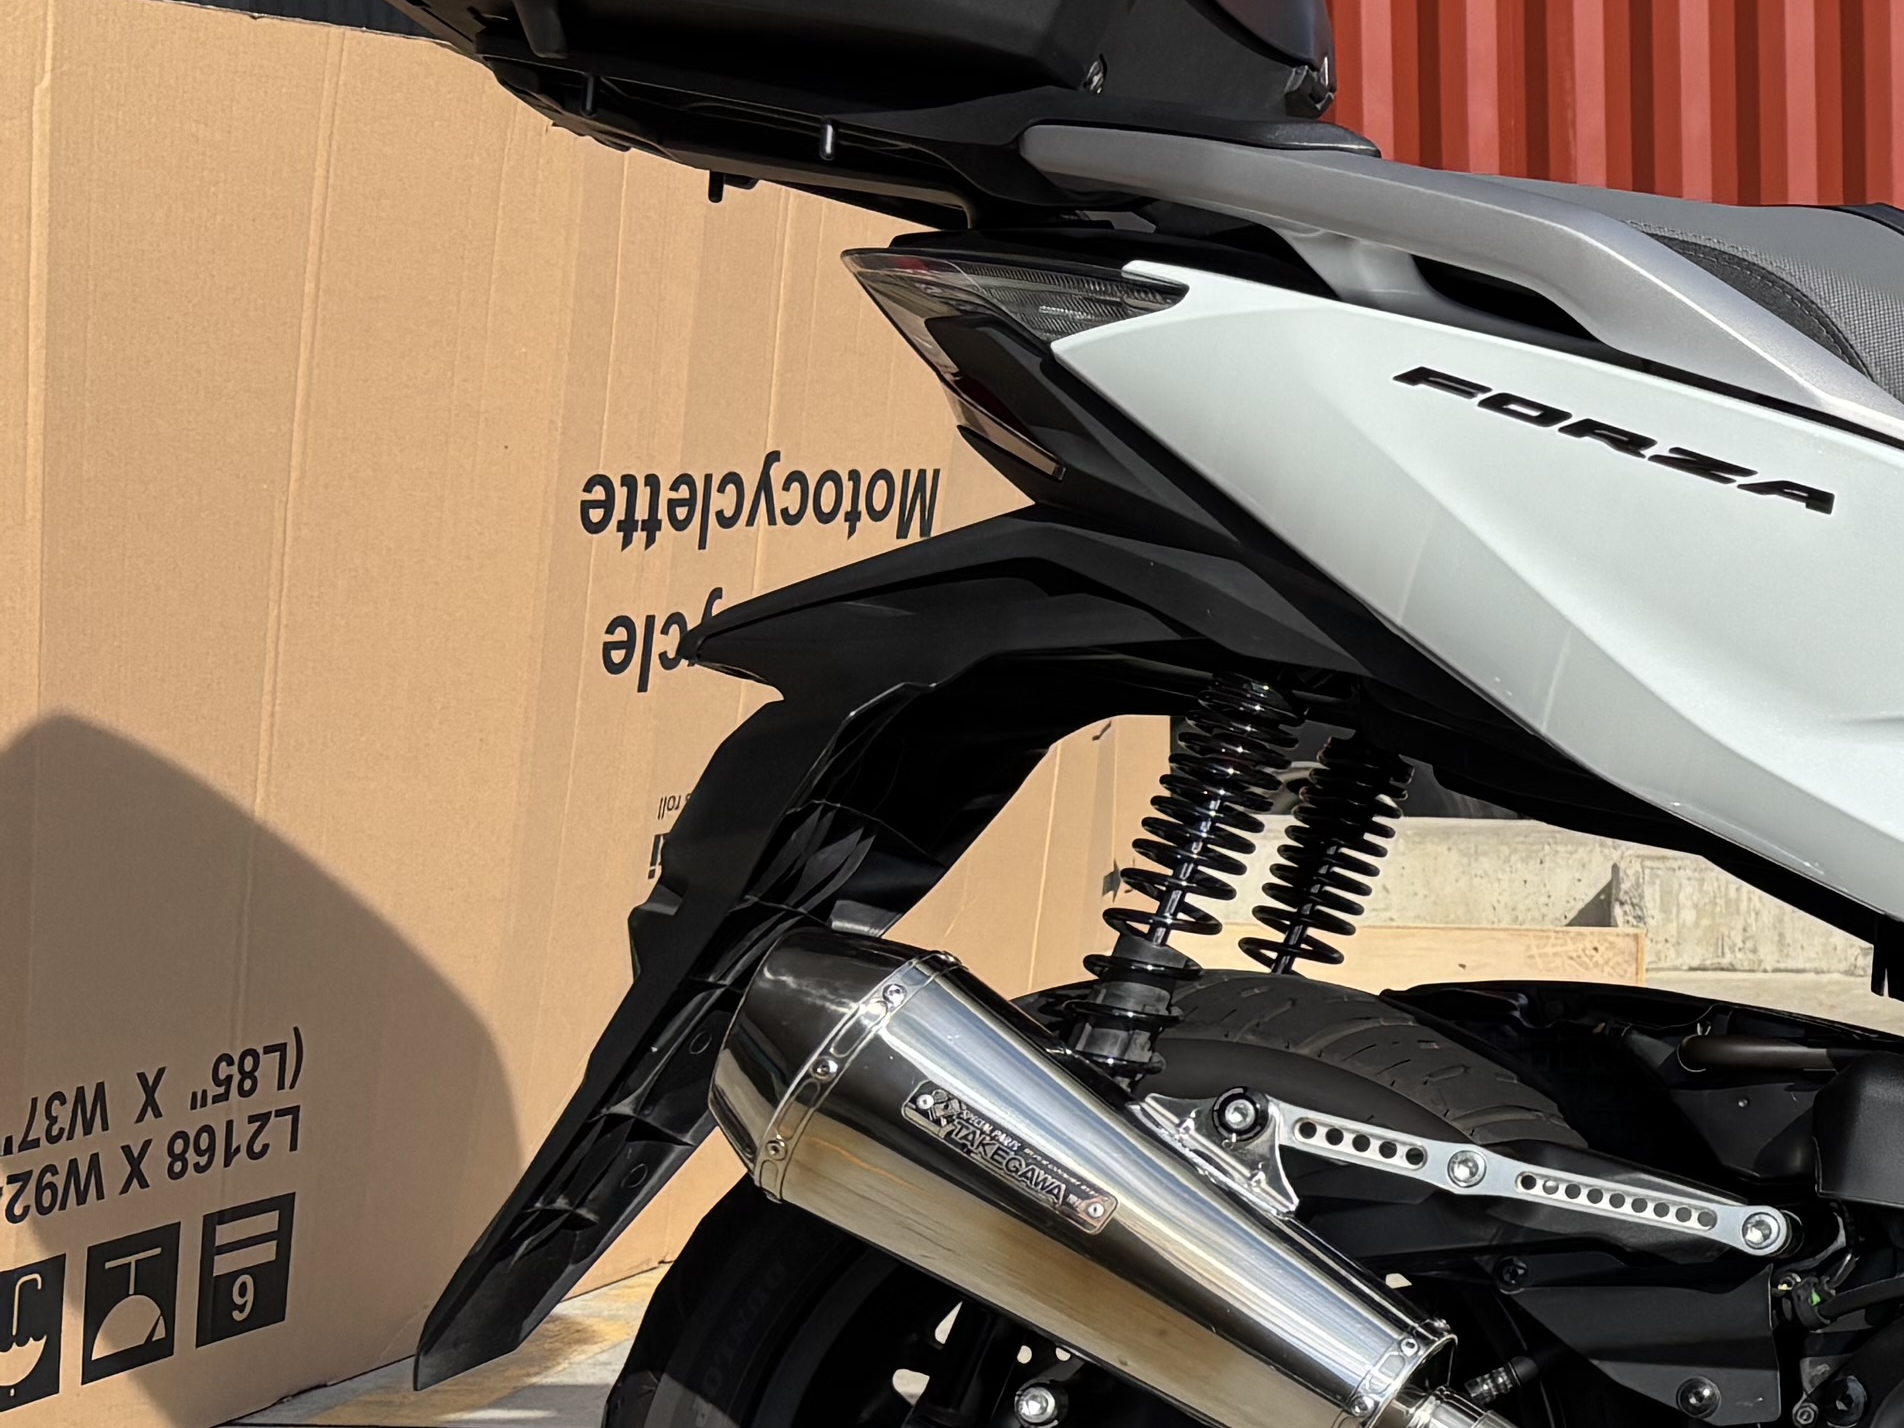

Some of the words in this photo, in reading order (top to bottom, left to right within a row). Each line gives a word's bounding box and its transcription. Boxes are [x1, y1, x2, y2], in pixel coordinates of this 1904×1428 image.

[1391, 365, 1836, 516] FORZA
[580, 450, 942, 551] Motocyclette
[133, 1066, 167, 1125] X
[118, 1138, 153, 1196] X
[166, 1105, 301, 1181] L2168
[950, 1118, 1068, 1205] TAKEGAWA
[0, 1151, 105, 1225] W92
